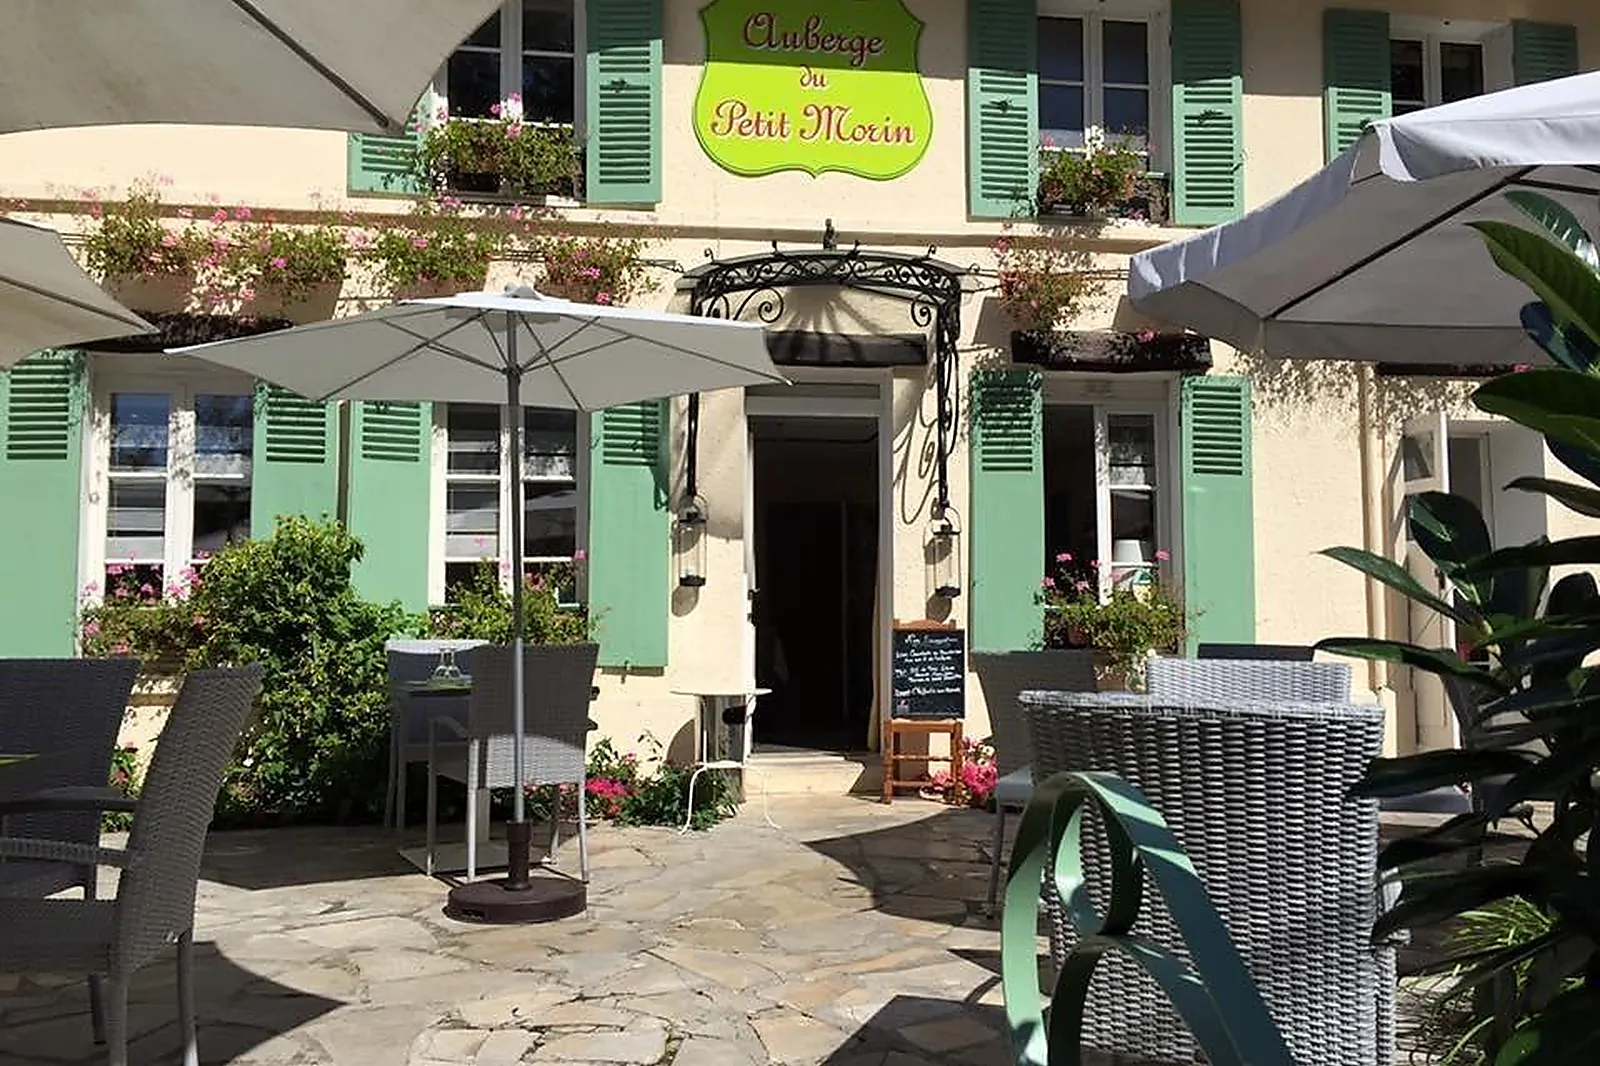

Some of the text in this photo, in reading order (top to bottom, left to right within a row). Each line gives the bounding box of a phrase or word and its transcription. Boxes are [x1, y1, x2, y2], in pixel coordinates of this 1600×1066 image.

[743, 12, 883, 66] Auberge
[799, 65, 828, 88] du
[711, 99, 915, 144] Petit Morin
